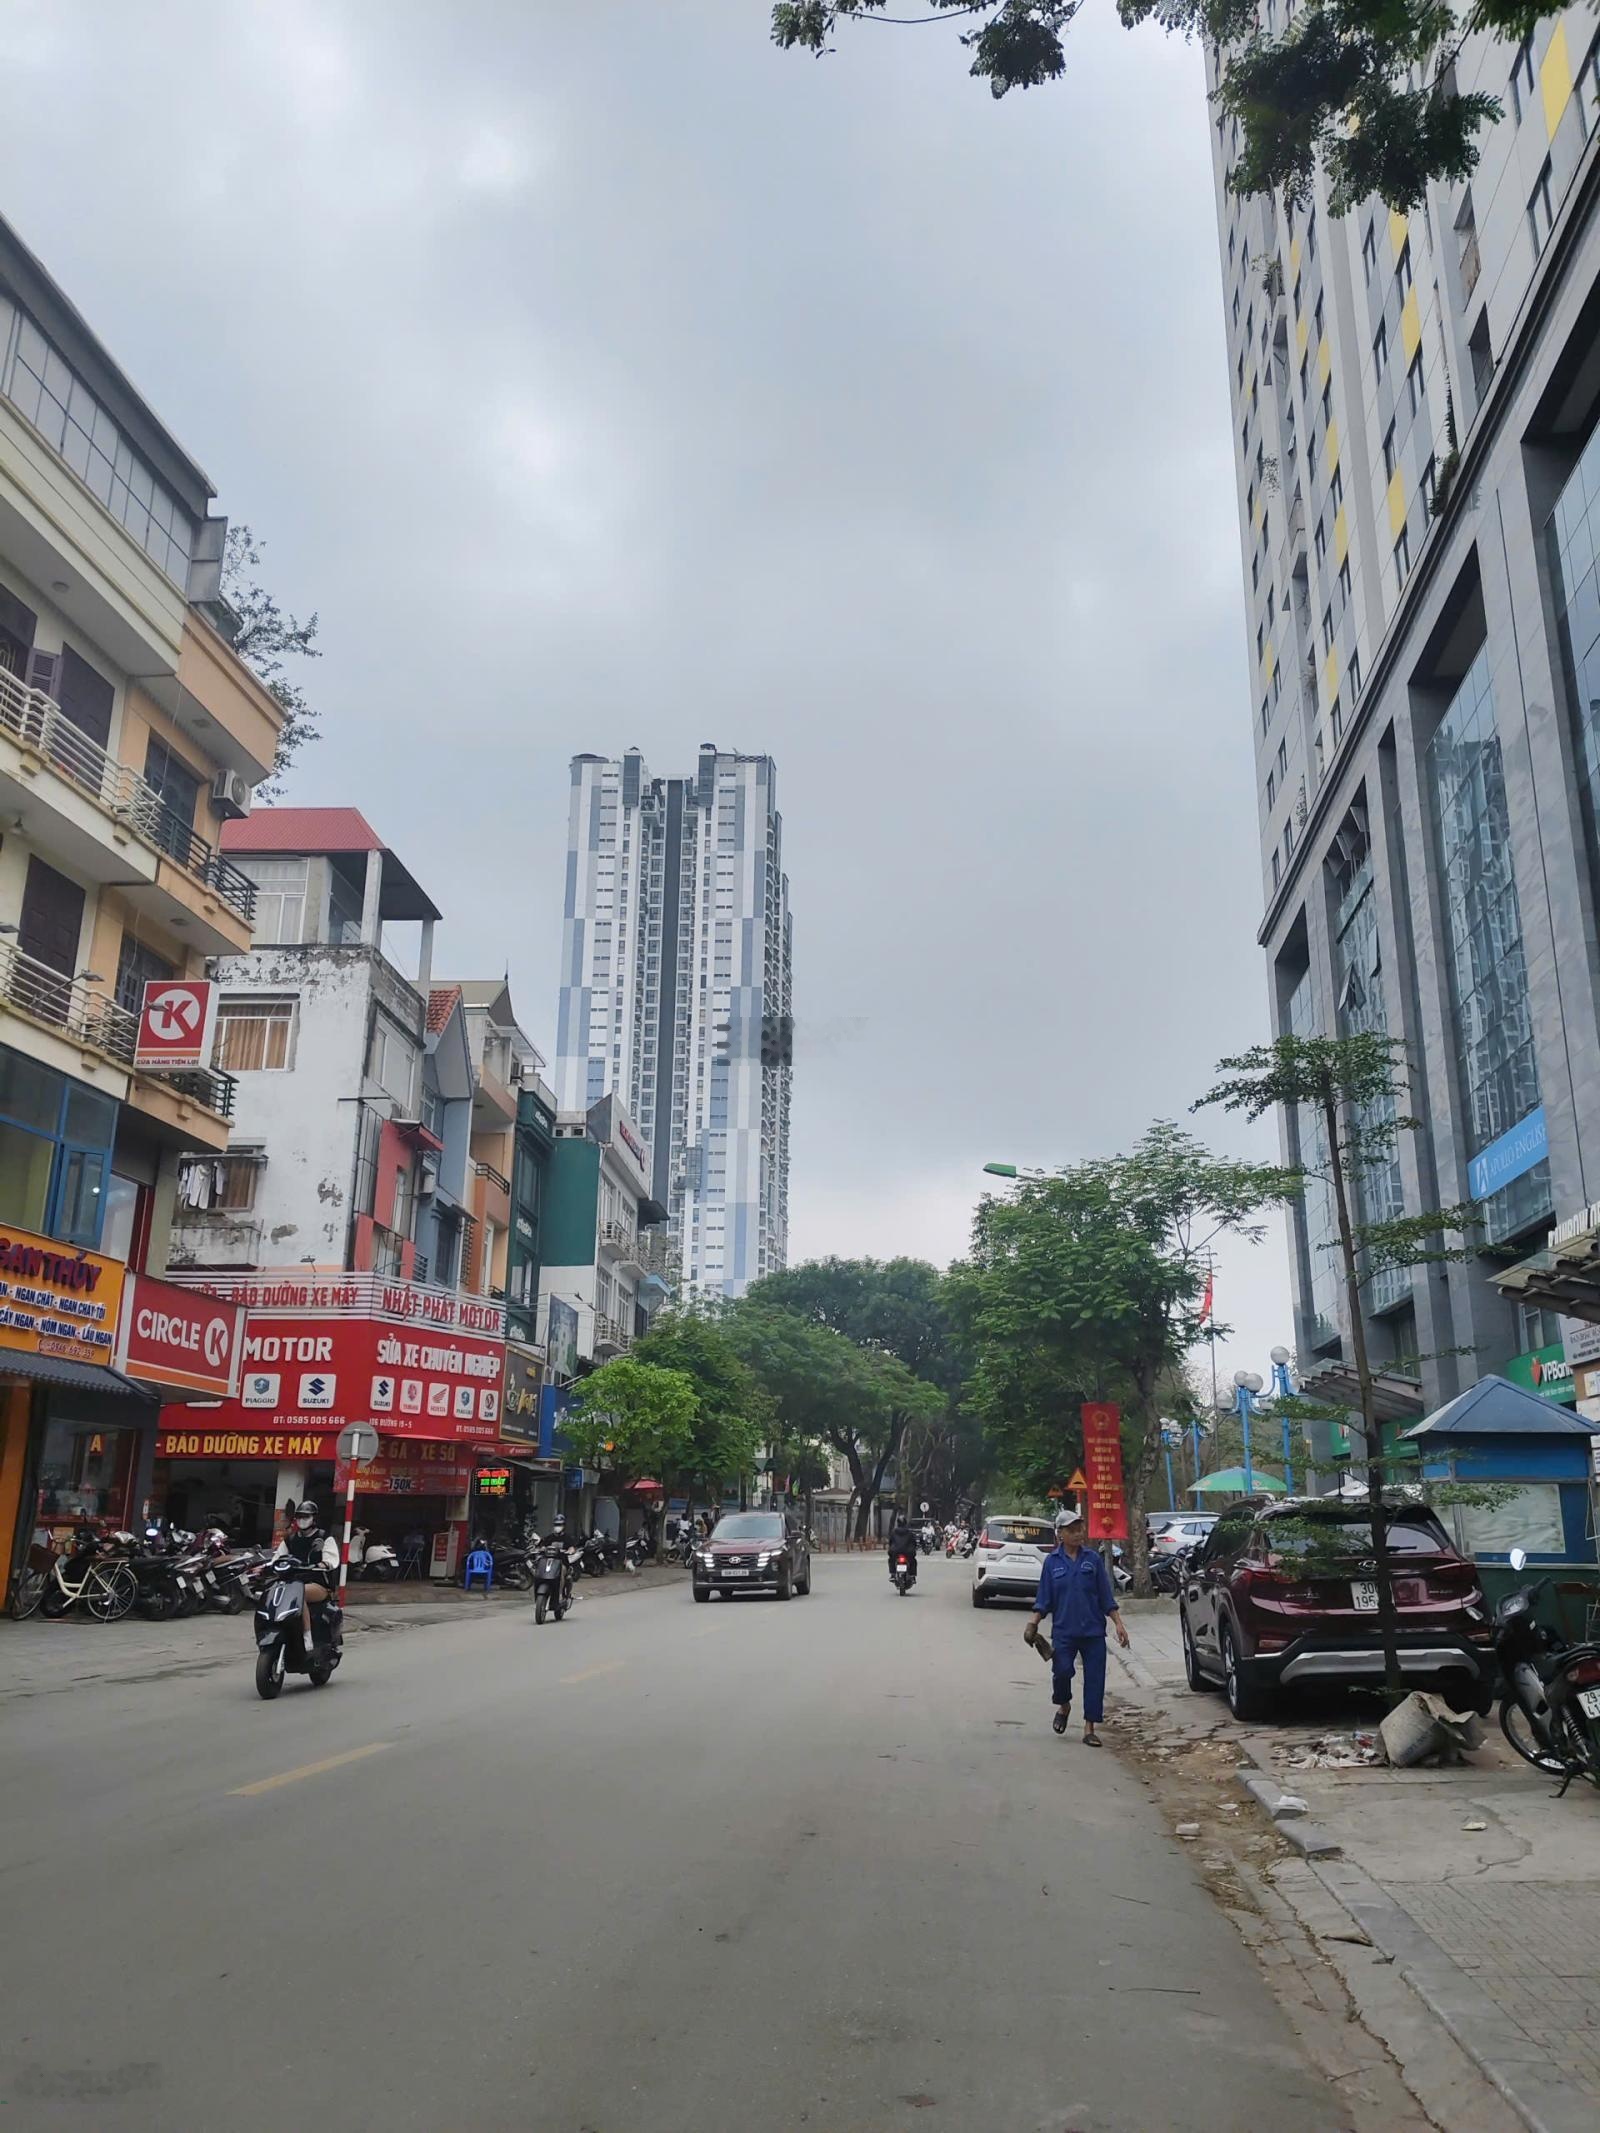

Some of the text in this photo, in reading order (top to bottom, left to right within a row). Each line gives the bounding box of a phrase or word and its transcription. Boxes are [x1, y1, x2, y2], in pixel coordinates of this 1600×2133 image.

[15, 1287, 35, 1301] NGAN
[59, 1298, 78, 1312] NGAN
[262, 1280, 308, 1306] DƯỠNG
[312, 1286, 328, 1306] XE
[331, 1280, 359, 1306] MÁY
[382, 1284, 500, 1331] NHẬT PHÁT MOTOR
[15, 1311, 35, 1328] NGAN
[95, 1331, 113, 1345] NGAN
[137, 1308, 200, 1351] CIRCLE
[243, 1336, 334, 1361] MOTOR
[376, 1332, 500, 1383] SỬA XE CHUYÊN NGHIỆP
[373, 1400, 390, 1408] SUZUKI
[287, 1416, 309, 1424] 0585
[310, 1416, 327, 1424] 005
[328, 1416, 345, 1424] 666
[166, 1432, 199, 1454] BẢO
[203, 1431, 259, 1455] DƯỠNG
[263, 1436, 284, 1455] XE
[288, 1432, 323, 1456] MÁY
[1360, 1582, 1378, 1595] 30
